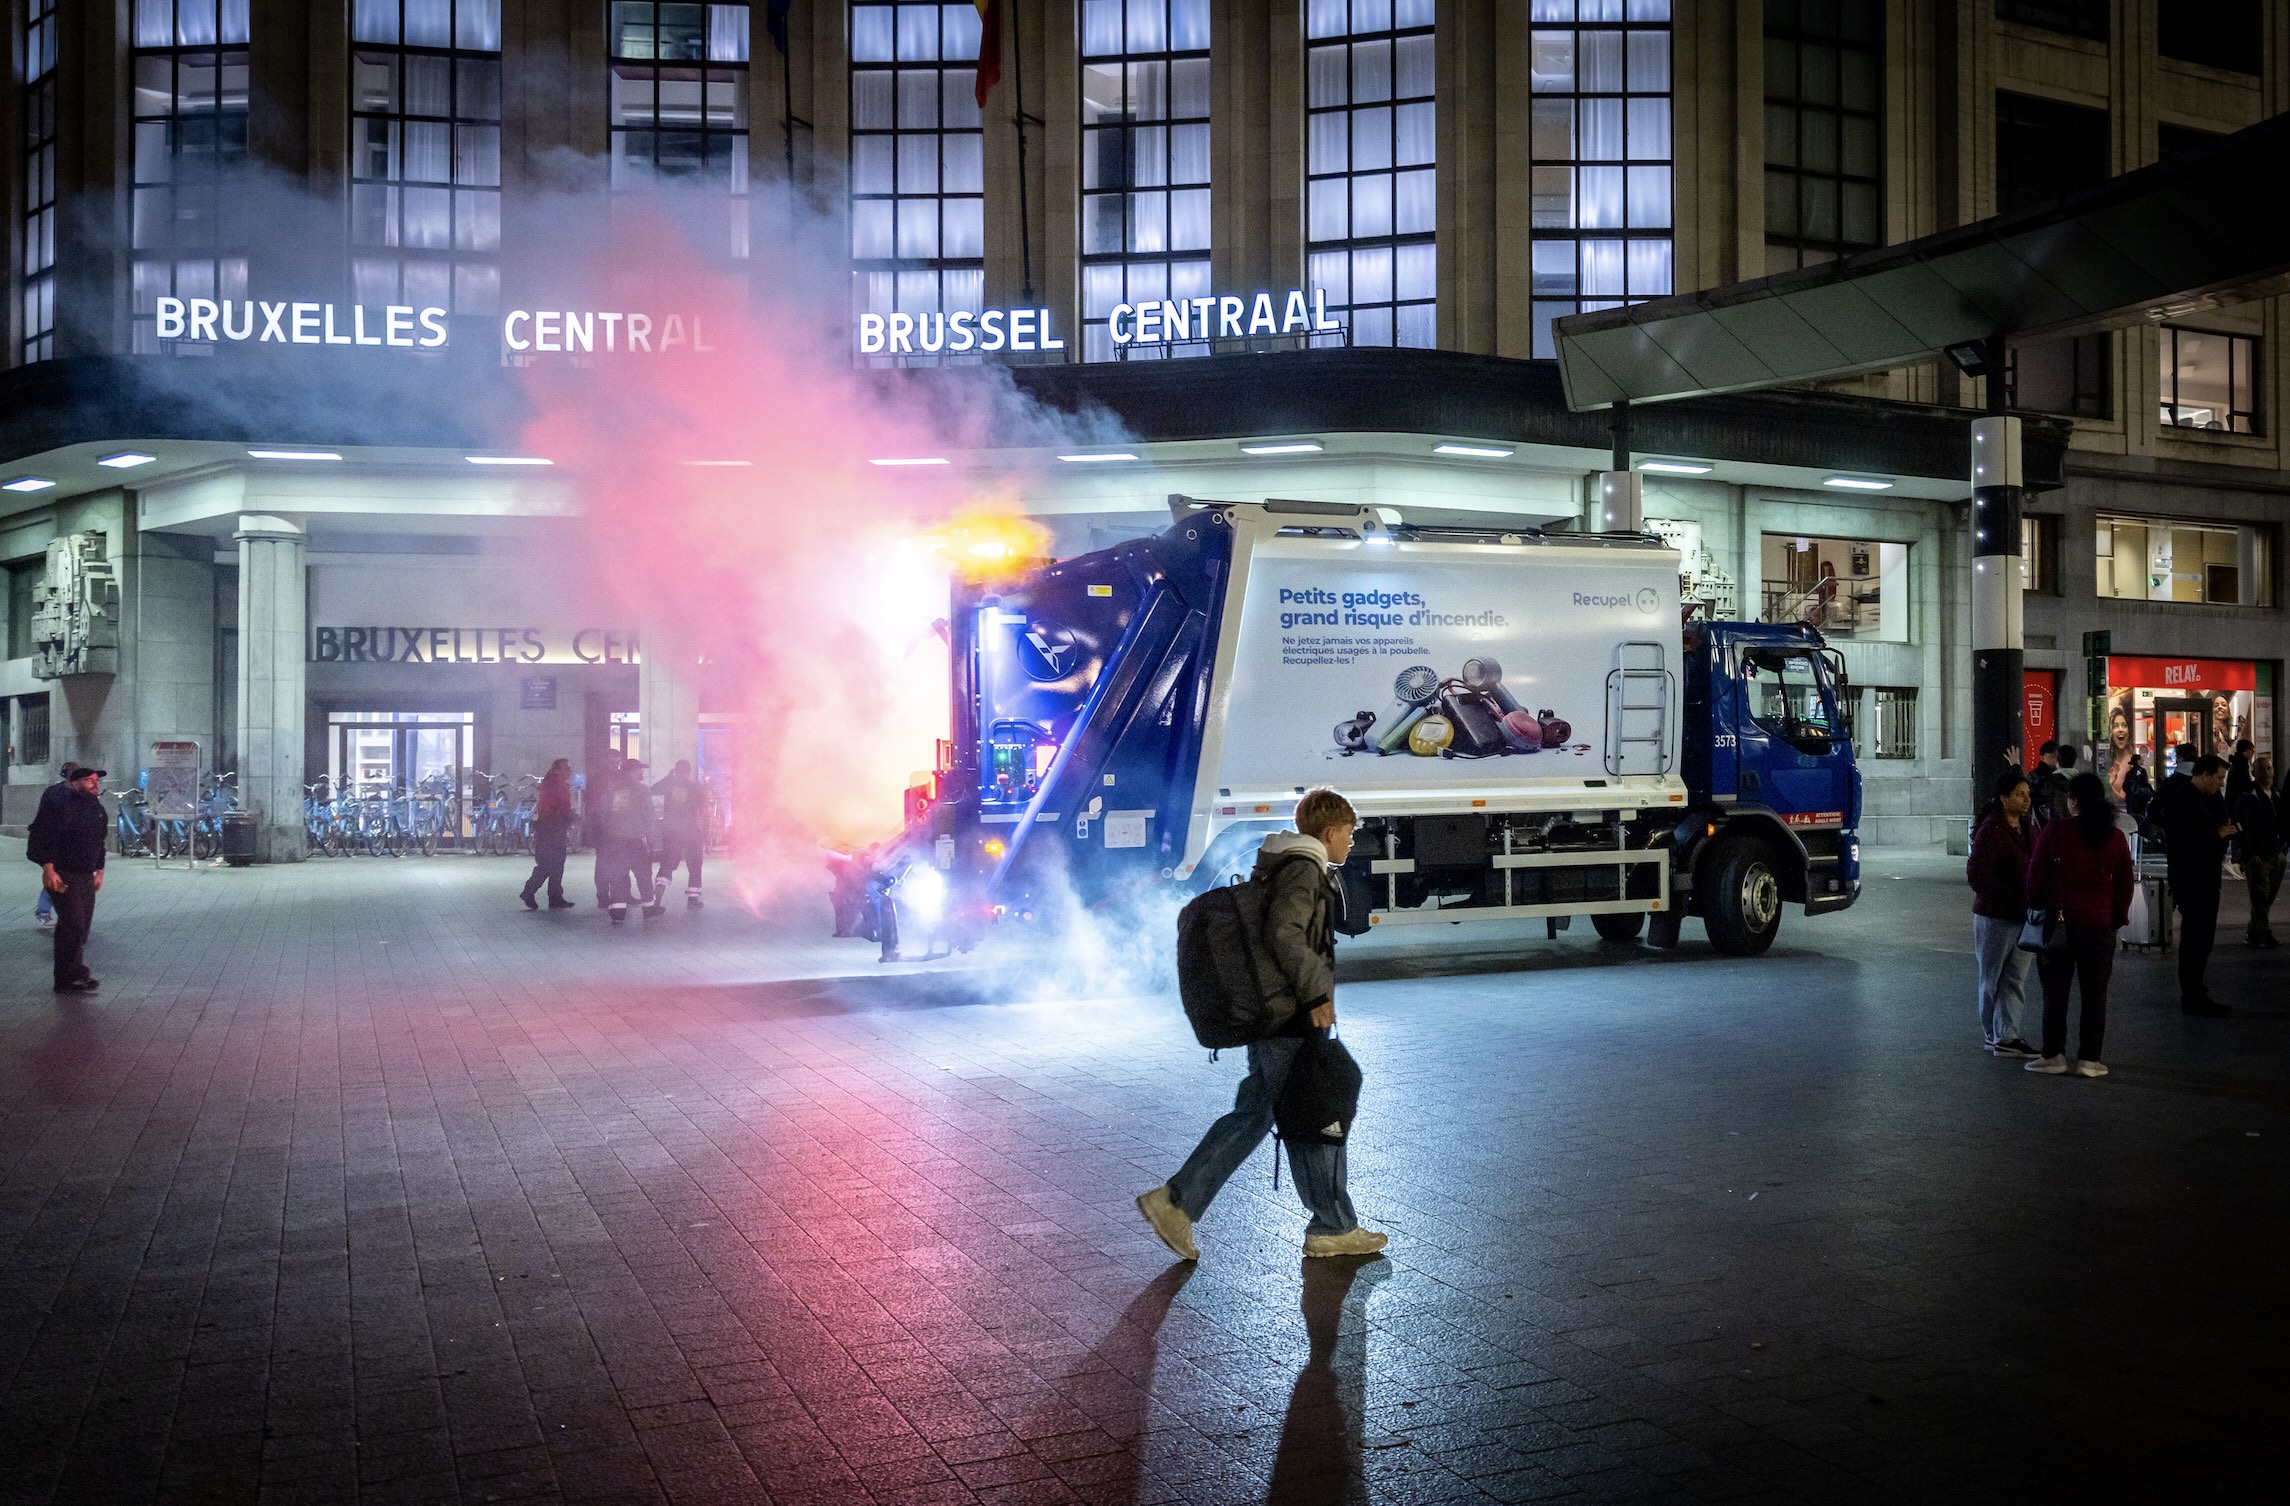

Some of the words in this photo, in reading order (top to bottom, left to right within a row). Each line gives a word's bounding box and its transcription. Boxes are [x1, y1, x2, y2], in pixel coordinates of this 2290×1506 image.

[156, 296, 447, 347] BRUXELLES
[504, 309, 715, 353] CENTRAL
[859, 308, 1064, 354] BRUSSEL
[1108, 288, 1341, 345] CENTRAAL
[1279, 587, 1337, 604] Petits
[1342, 589, 1426, 609] gadgets,
[1573, 592, 1632, 608] Recupel
[1280, 609, 1338, 629] grand
[1345, 609, 1404, 629] risque
[1409, 609, 1509, 627] d'incendie.
[316, 626, 546, 664] BRUXELLES
[1282, 637, 1295, 645] Ne
[1297, 636, 1320, 647] jetez
[1322, 636, 1353, 647] jamais
[1373, 636, 1414, 647] appareils
[1282, 646, 1334, 656] électriques
[1337, 646, 1369, 657] usagés
[1372, 646, 1377, 655] à
[1380, 646, 1387, 655] la
[1390, 646, 1431, 657] poubelle.
[1283, 656, 1350, 666] Recupellez-les
[2165, 663, 2198, 685] RELAY
[1714, 734, 1736, 748] 3573
